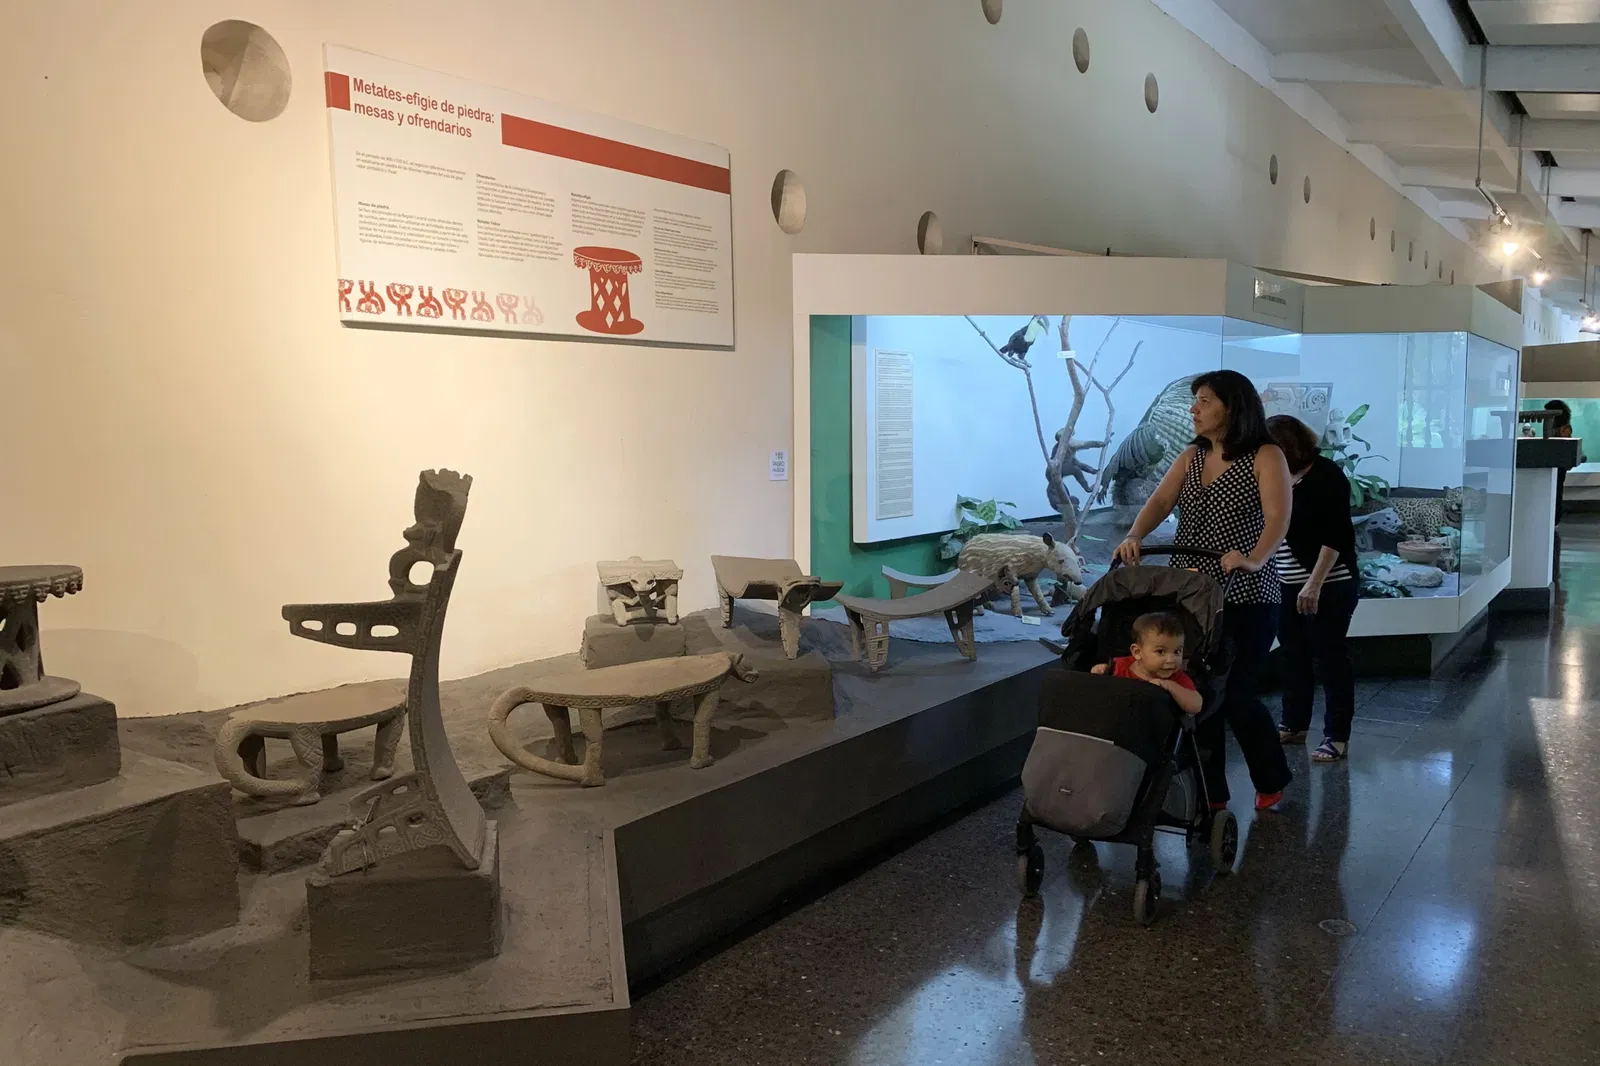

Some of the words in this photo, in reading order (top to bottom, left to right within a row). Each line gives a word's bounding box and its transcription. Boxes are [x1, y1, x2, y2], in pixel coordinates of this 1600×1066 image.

[353, 78, 438, 111] Metates-efigie
[441, 100, 455, 114] de
[457, 104, 495, 124] piedra:
[354, 102, 395, 121] mesas
[397, 112, 405, 126] y
[407, 113, 472, 138] ofrendarios
